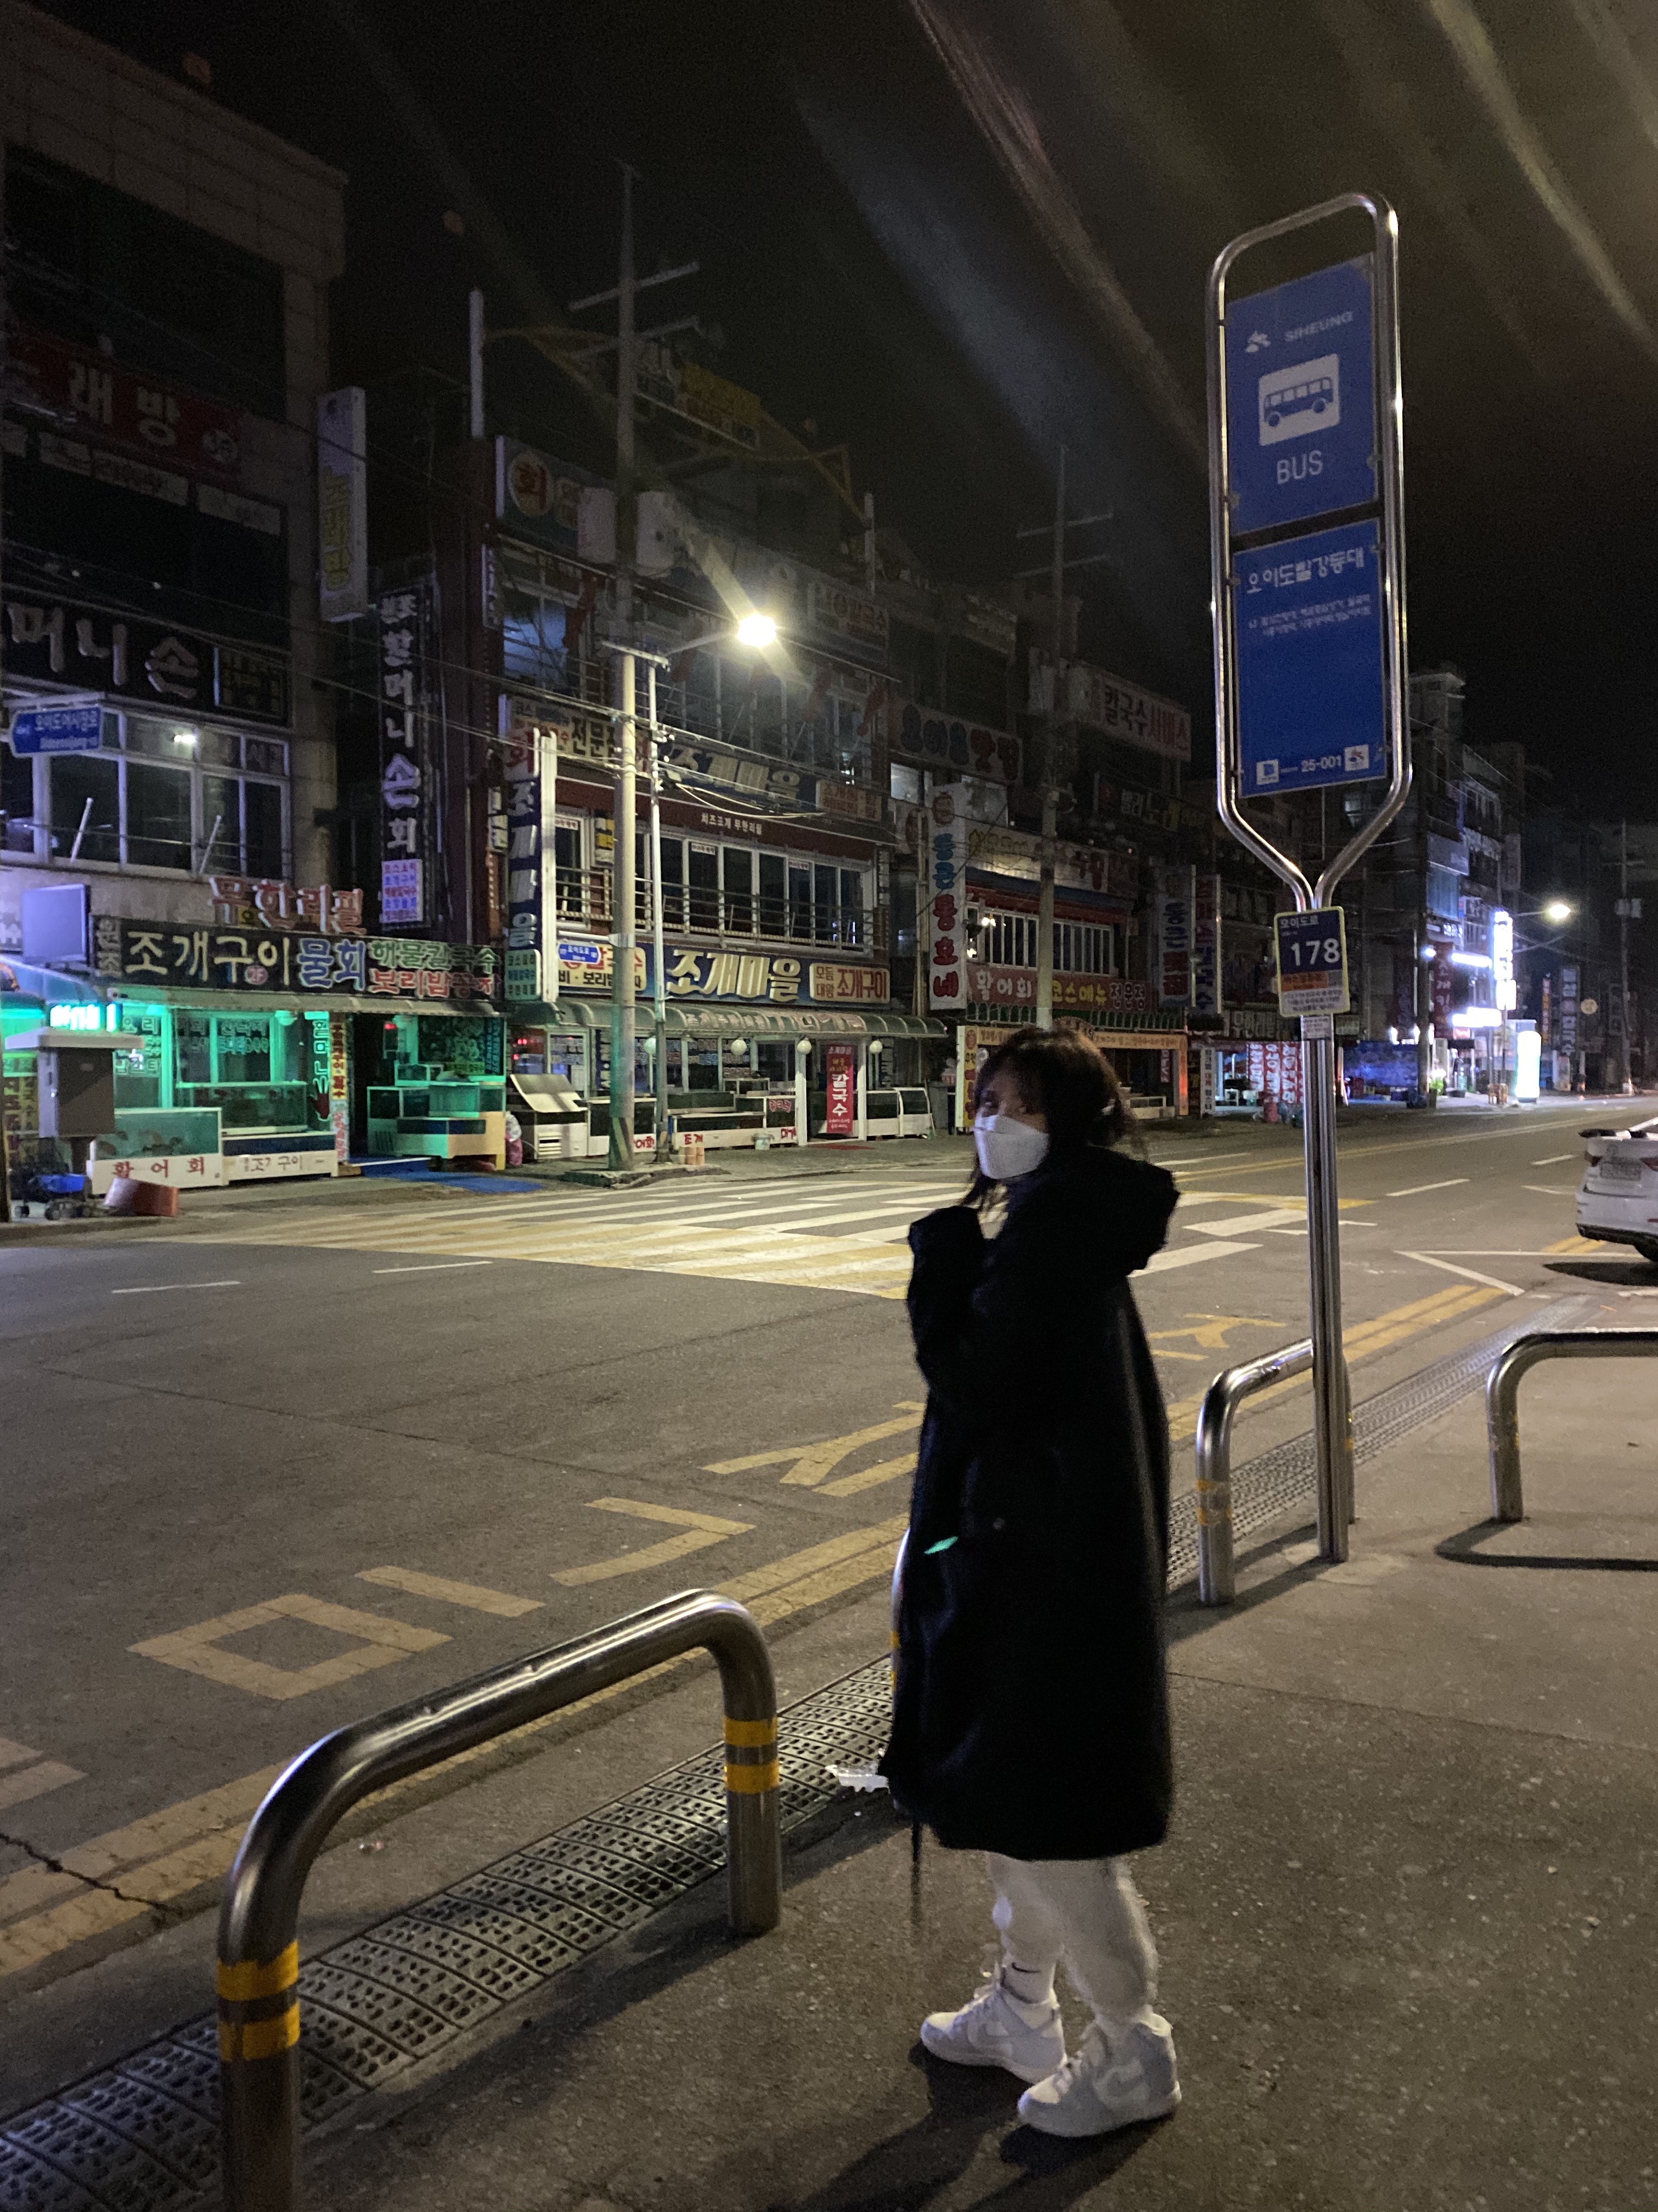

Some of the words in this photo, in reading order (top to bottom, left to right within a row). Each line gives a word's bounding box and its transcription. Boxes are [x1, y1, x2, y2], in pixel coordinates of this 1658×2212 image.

[1285, 311, 1354, 342] SIHEUNG
[1277, 450, 1323, 485] BUS
[1301, 754, 1342, 772] 25-001
[209, 876, 368, 935] 무한리필
[1280, 915, 1319, 929] 오이도로
[126, 930, 292, 986] 조개구이
[297, 938, 366, 992] 물회
[369, 940, 501, 975] 해물칼국수
[1290, 938, 1340, 967] 178
[666, 949, 802, 1002] 조개마을
[837, 967, 888, 1000] 조개구이
[976, 970, 1033, 1001] 활어회
[1052, 979, 1107, 1006] 코스메뉴
[831, 1073, 850, 1117] 칼국수
